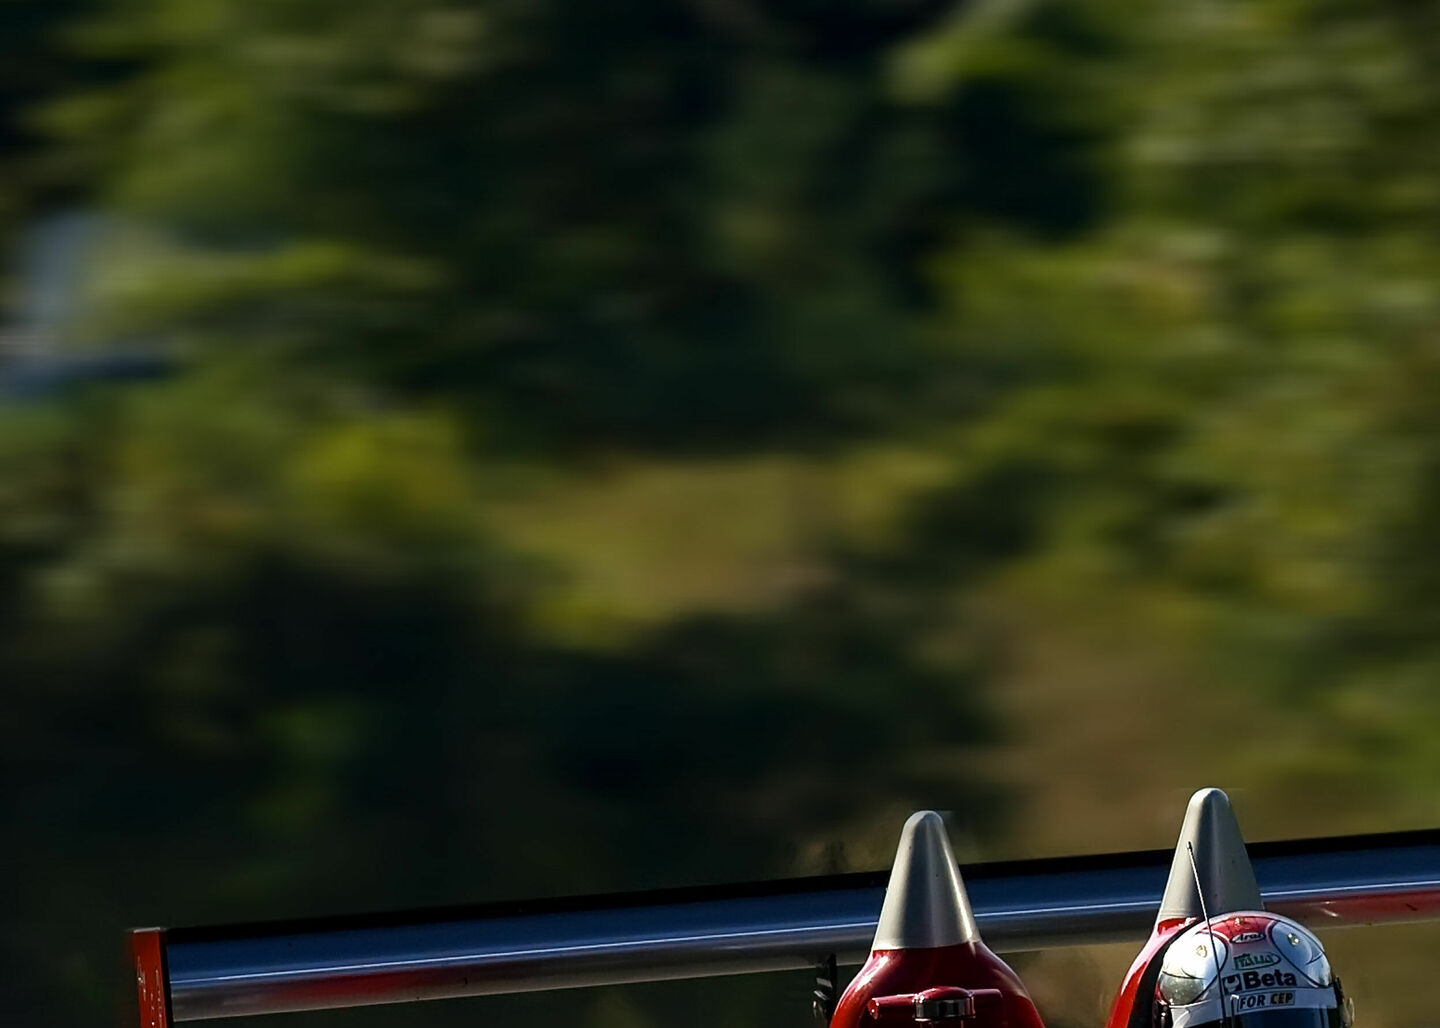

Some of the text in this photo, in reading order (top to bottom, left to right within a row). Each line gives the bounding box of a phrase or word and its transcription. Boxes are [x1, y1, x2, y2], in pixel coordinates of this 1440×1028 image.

[1243, 969, 1297, 989] Beta
[1240, 992, 1293, 1010] FOR CEP
